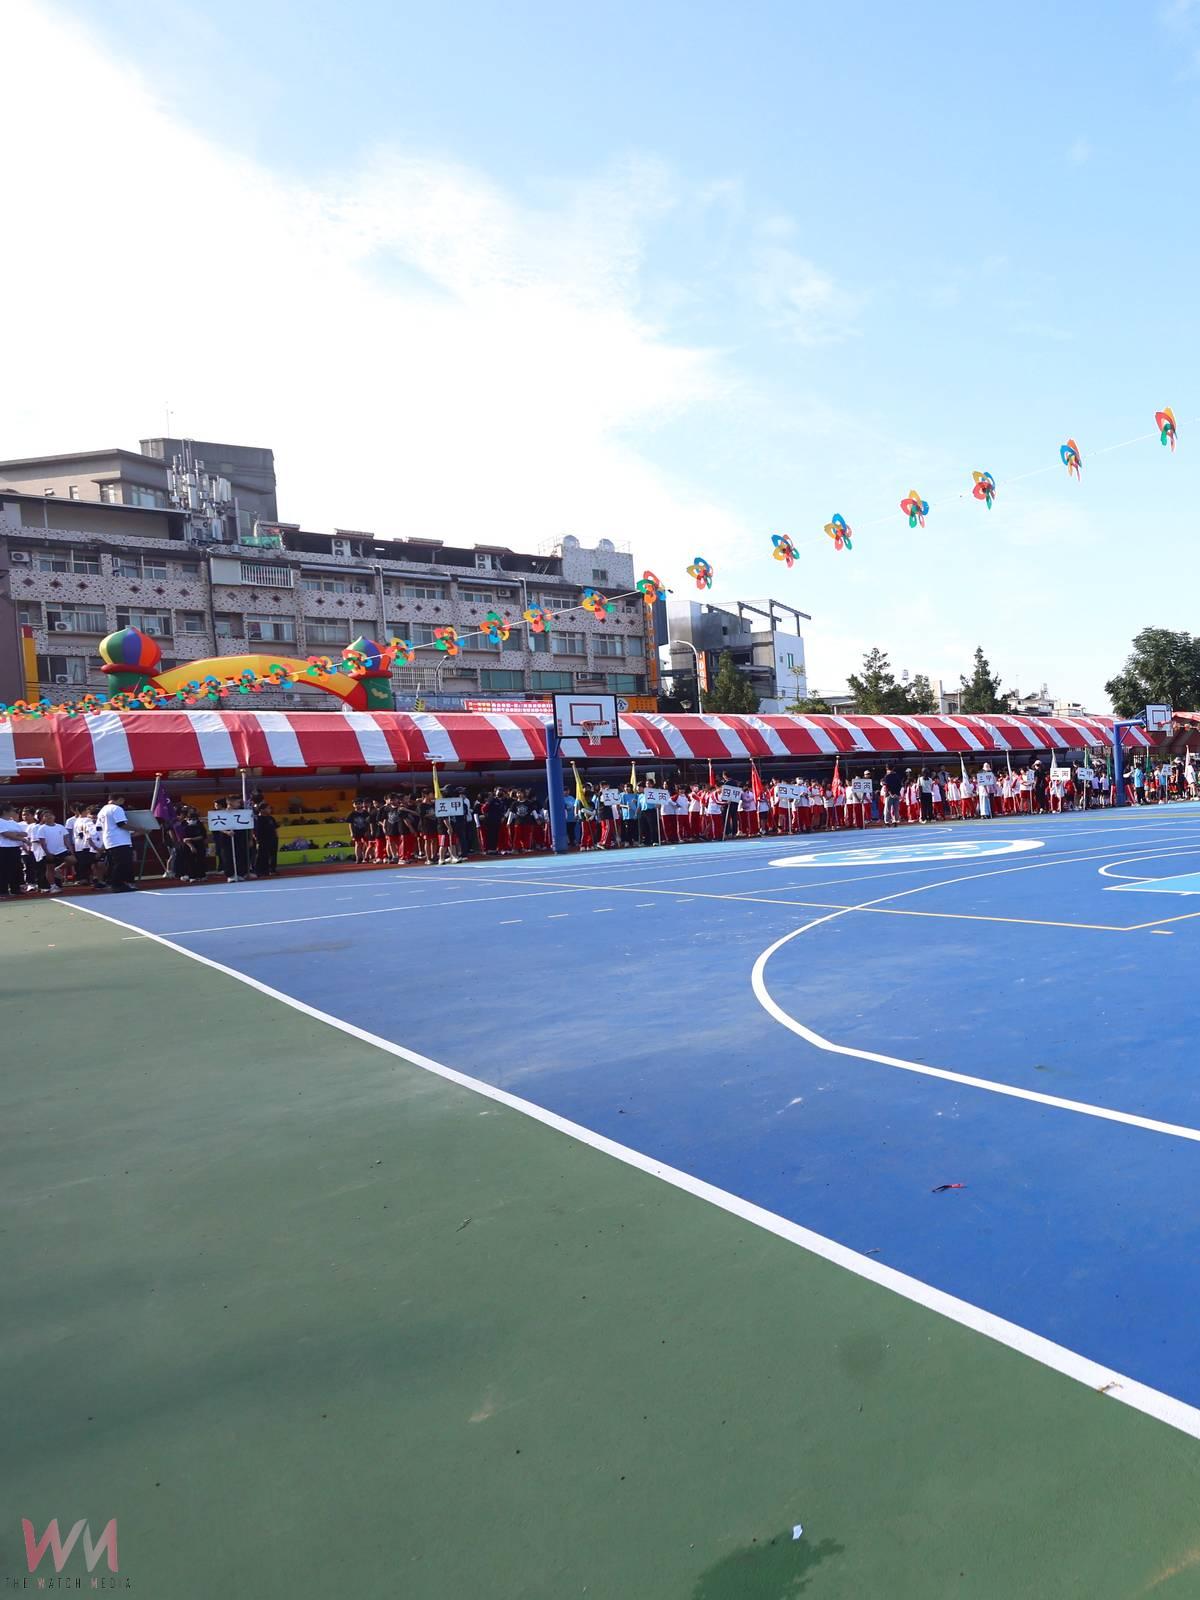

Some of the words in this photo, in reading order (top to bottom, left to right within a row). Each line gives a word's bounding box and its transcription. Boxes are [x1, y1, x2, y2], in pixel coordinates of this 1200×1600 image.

[779, 786, 798, 796] 四乙
[853, 782, 871, 790] 四丙
[647, 792, 667, 800] 五丙
[723, 788, 740, 798] 四甲
[438, 802, 461, 812] 五甲
[211, 814, 250, 826] 六乙
